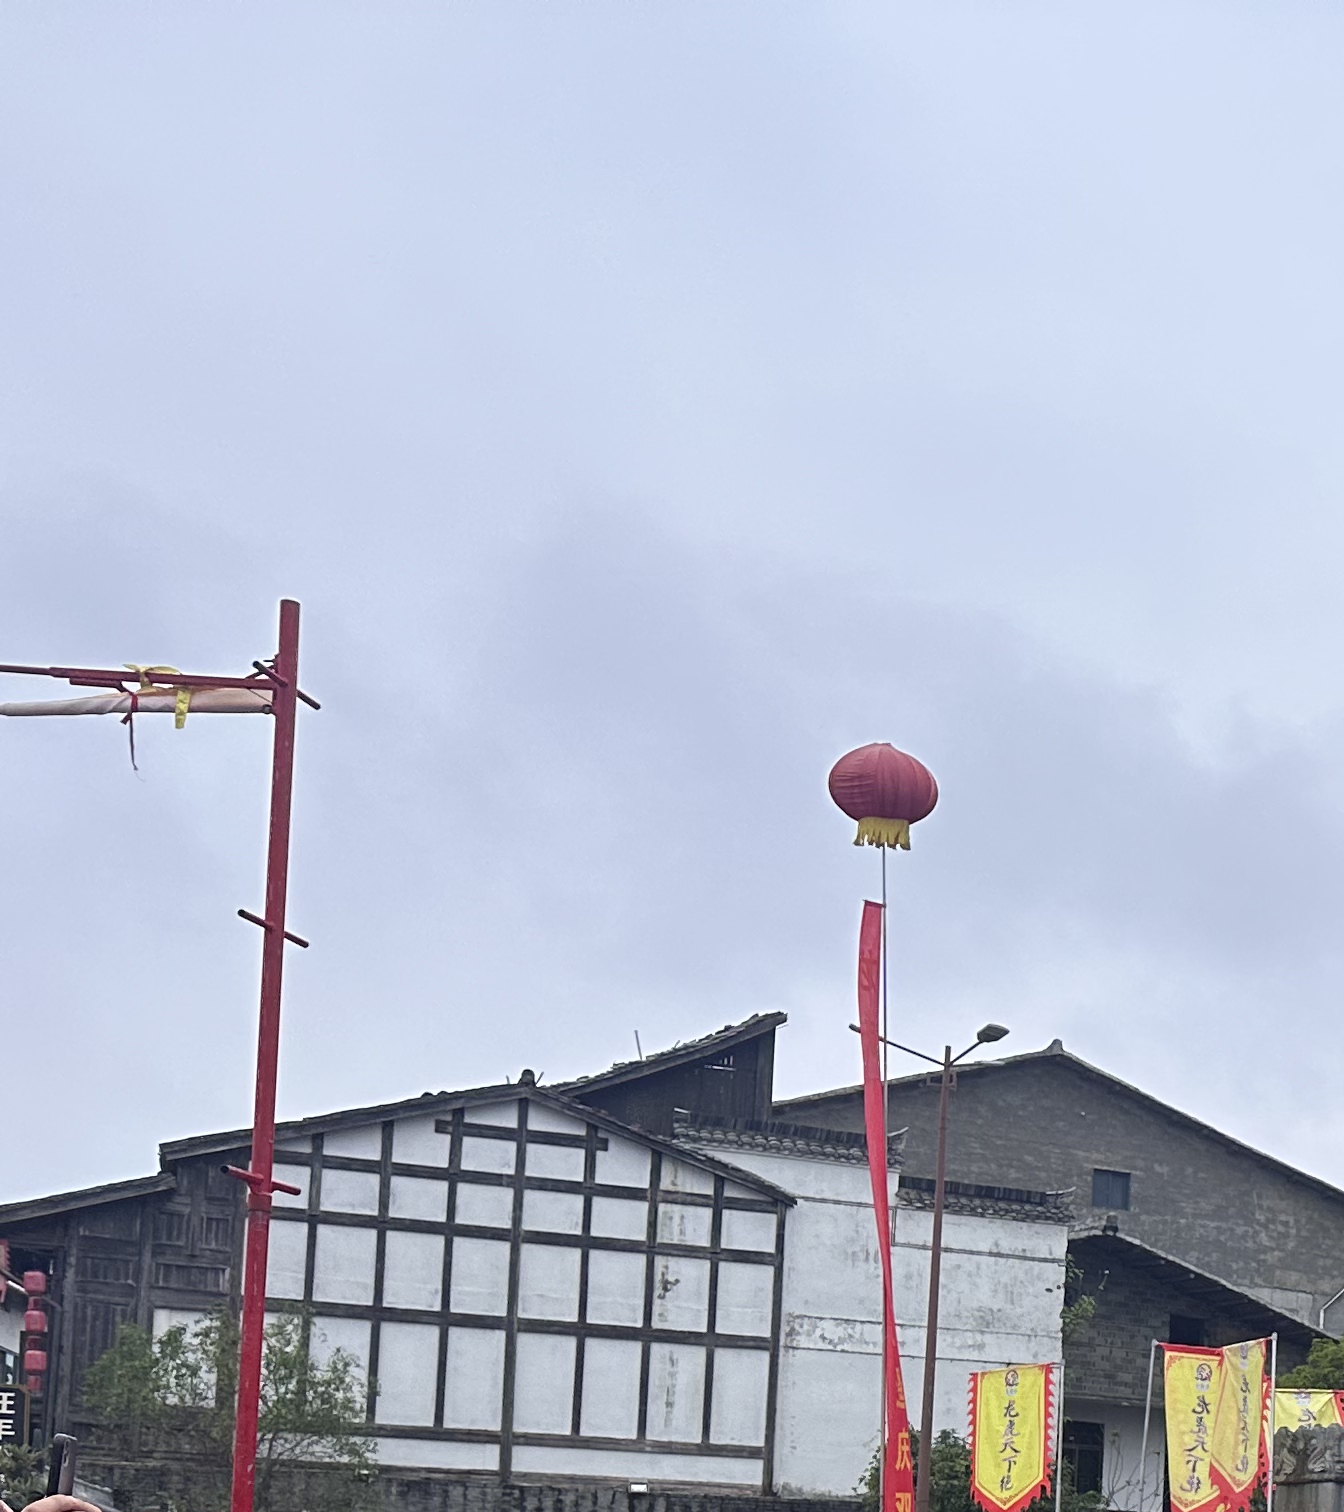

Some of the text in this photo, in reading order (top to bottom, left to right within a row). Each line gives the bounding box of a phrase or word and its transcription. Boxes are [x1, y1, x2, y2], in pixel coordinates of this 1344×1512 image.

[999, 1400, 1021, 1493] 龙虎天下绝
